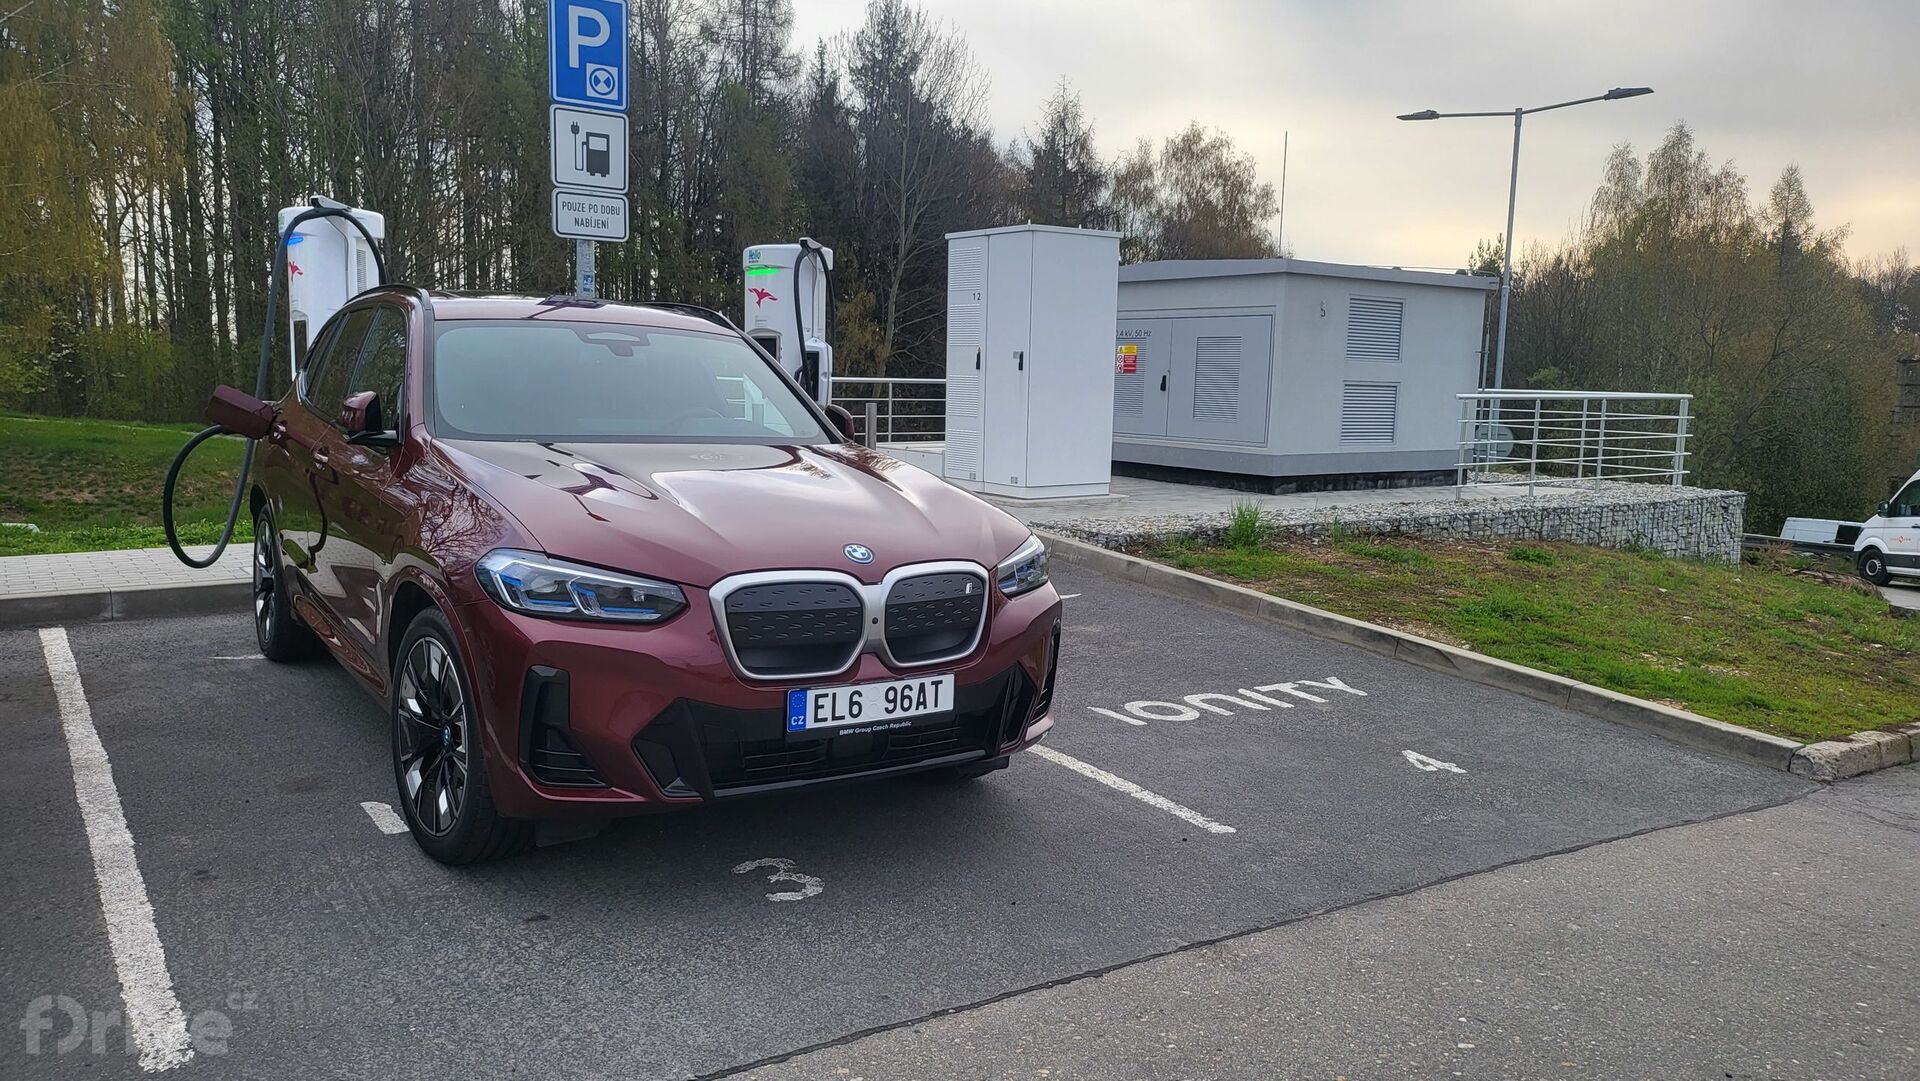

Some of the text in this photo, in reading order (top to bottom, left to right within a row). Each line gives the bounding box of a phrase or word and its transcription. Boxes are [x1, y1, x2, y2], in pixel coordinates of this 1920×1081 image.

[568, 5, 611, 69] P
[562, 201, 620, 216] POUZE PO DOBU
[574, 217, 609, 229] NABÍJENÍ
[813, 679, 944, 724] EL6 96AT
[1087, 676, 1368, 726] IONITY
[791, 715, 805, 726] CZ
[839, 728, 855, 736] BMW
[855, 727, 872, 735] Group
[889, 721, 912, 730] Republic
[1401, 749, 1468, 775] 4
[731, 857, 826, 902] 3
